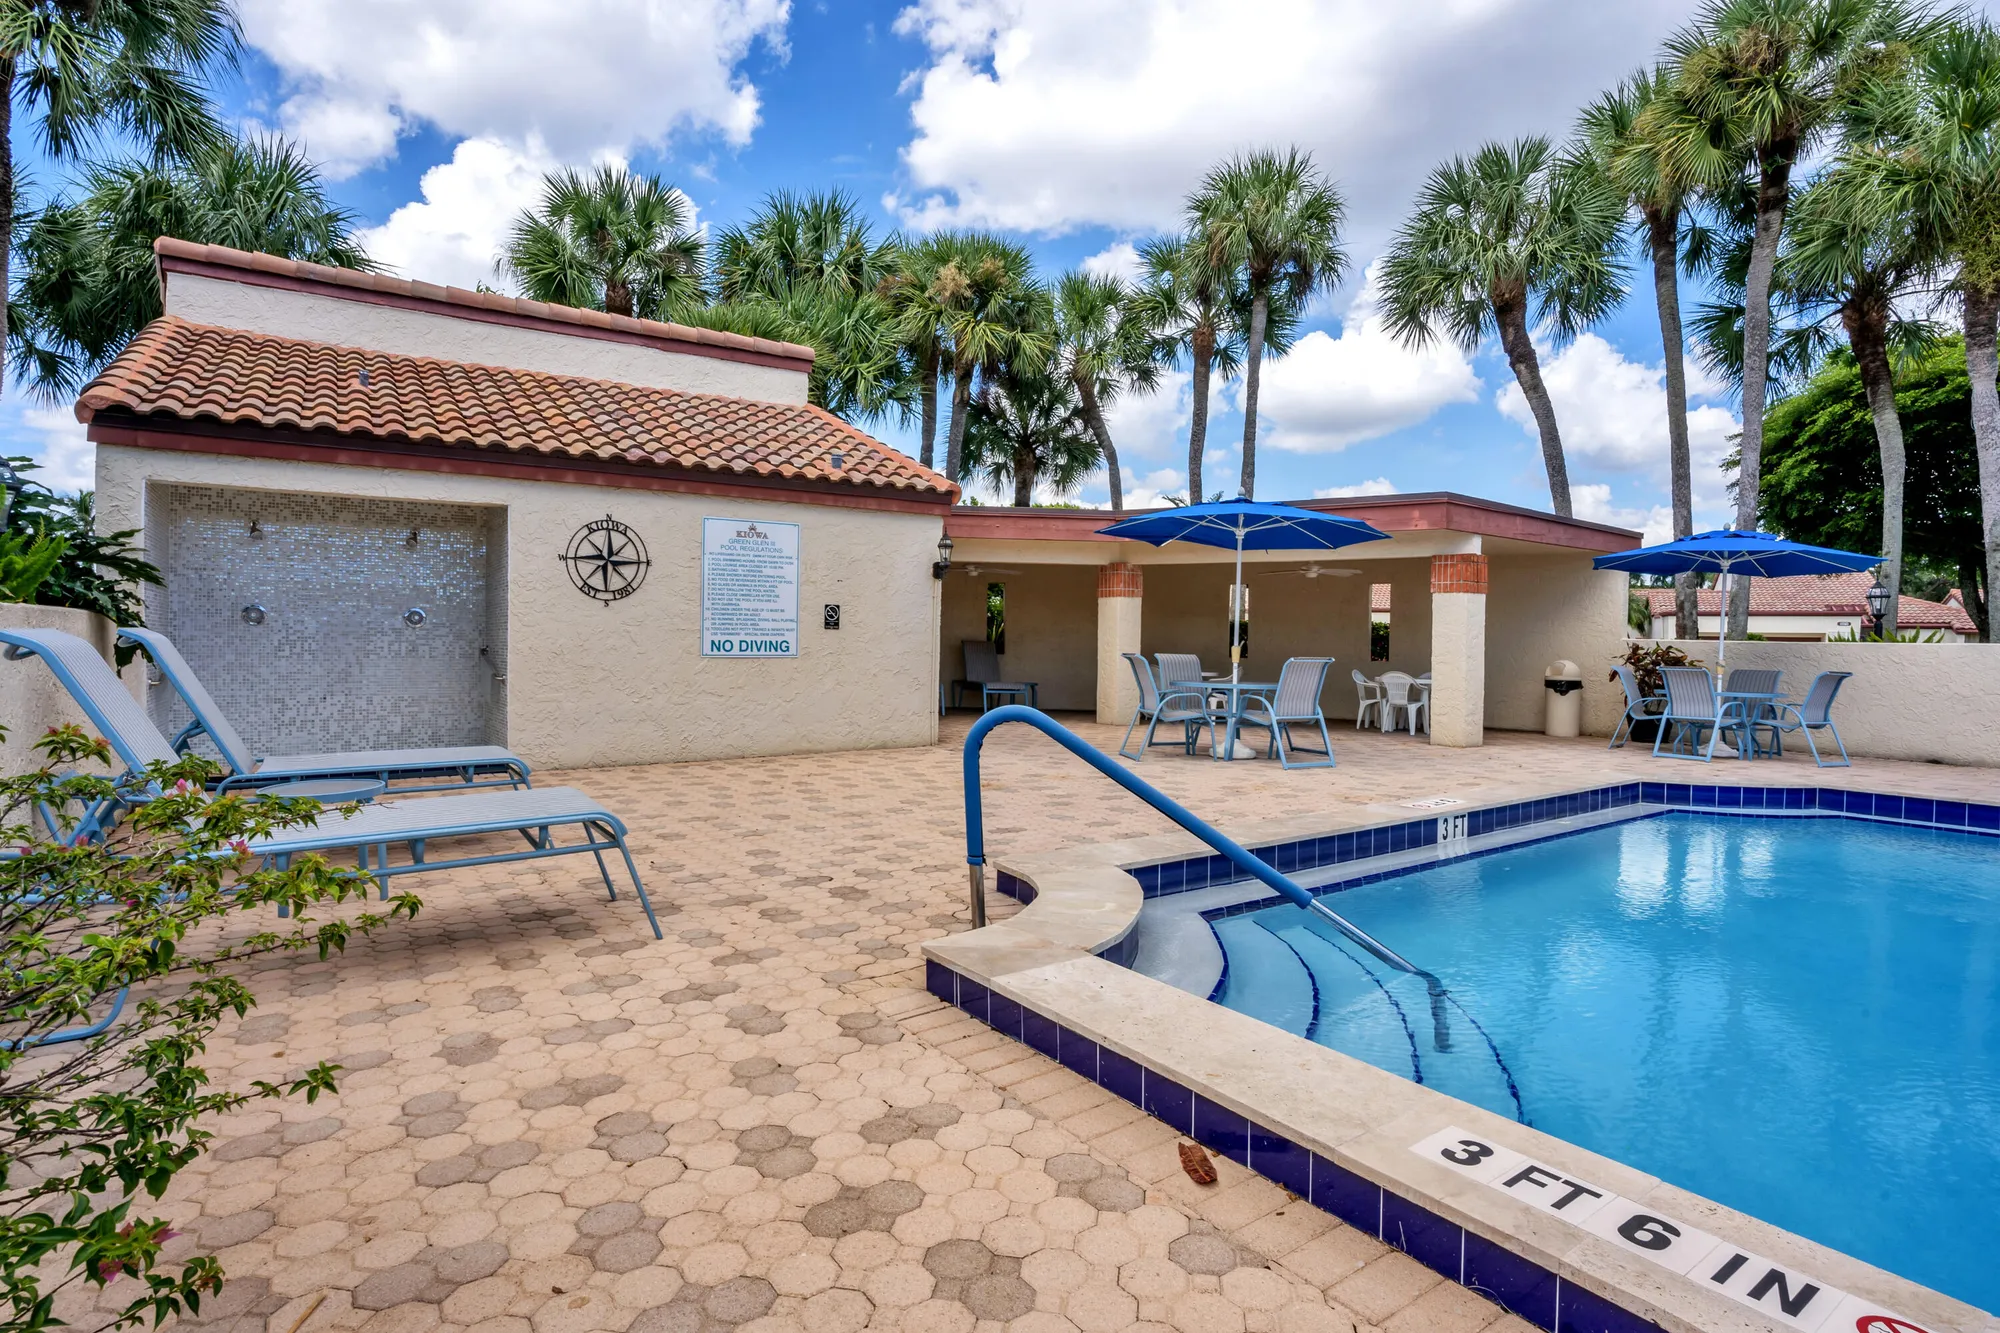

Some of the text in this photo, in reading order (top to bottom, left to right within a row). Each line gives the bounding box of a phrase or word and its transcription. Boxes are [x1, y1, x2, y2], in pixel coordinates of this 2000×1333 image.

[585, 519, 628, 535] KIOWA
[736, 531, 768, 539] KIOWA
[613, 584, 635, 600] 1981
[711, 640, 790, 652] NO DIVING
[1442, 814, 1466, 840] 3 FT
[1440, 1139, 1821, 1318] 3 FT 6 IN
